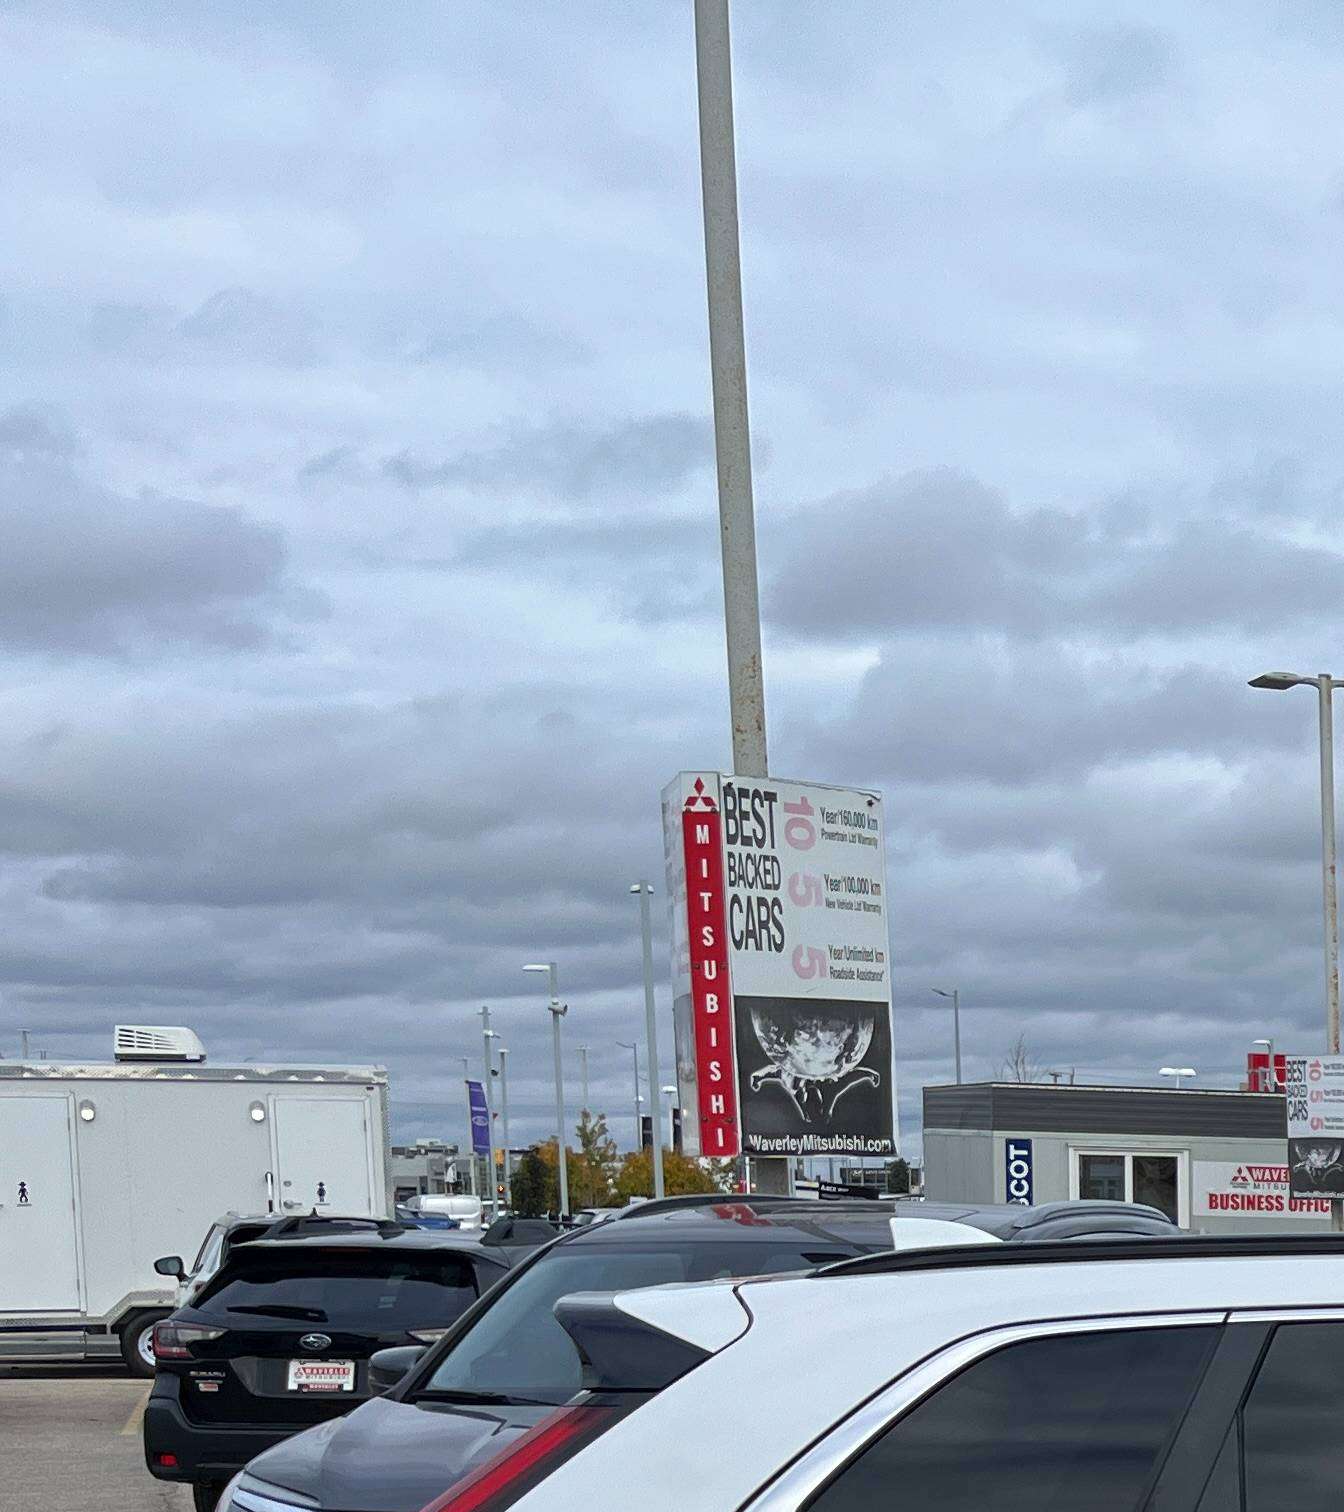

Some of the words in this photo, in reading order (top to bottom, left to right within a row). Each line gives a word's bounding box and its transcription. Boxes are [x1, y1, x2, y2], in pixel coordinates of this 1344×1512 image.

[723, 784, 778, 849] BEST
[727, 851, 782, 891] BACKED
[729, 894, 785, 954] CARS
[696, 824, 725, 1147] MITSUBISHI
[1286, 1060, 1307, 1082] BEST
[1287, 1100, 1309, 1121] CARS
[749, 1134, 892, 1153] WaverleyMitsubishi.com
[1208, 1193, 1285, 1212] BUSINESS
[1289, 1199, 1331, 1213] OFFIC
